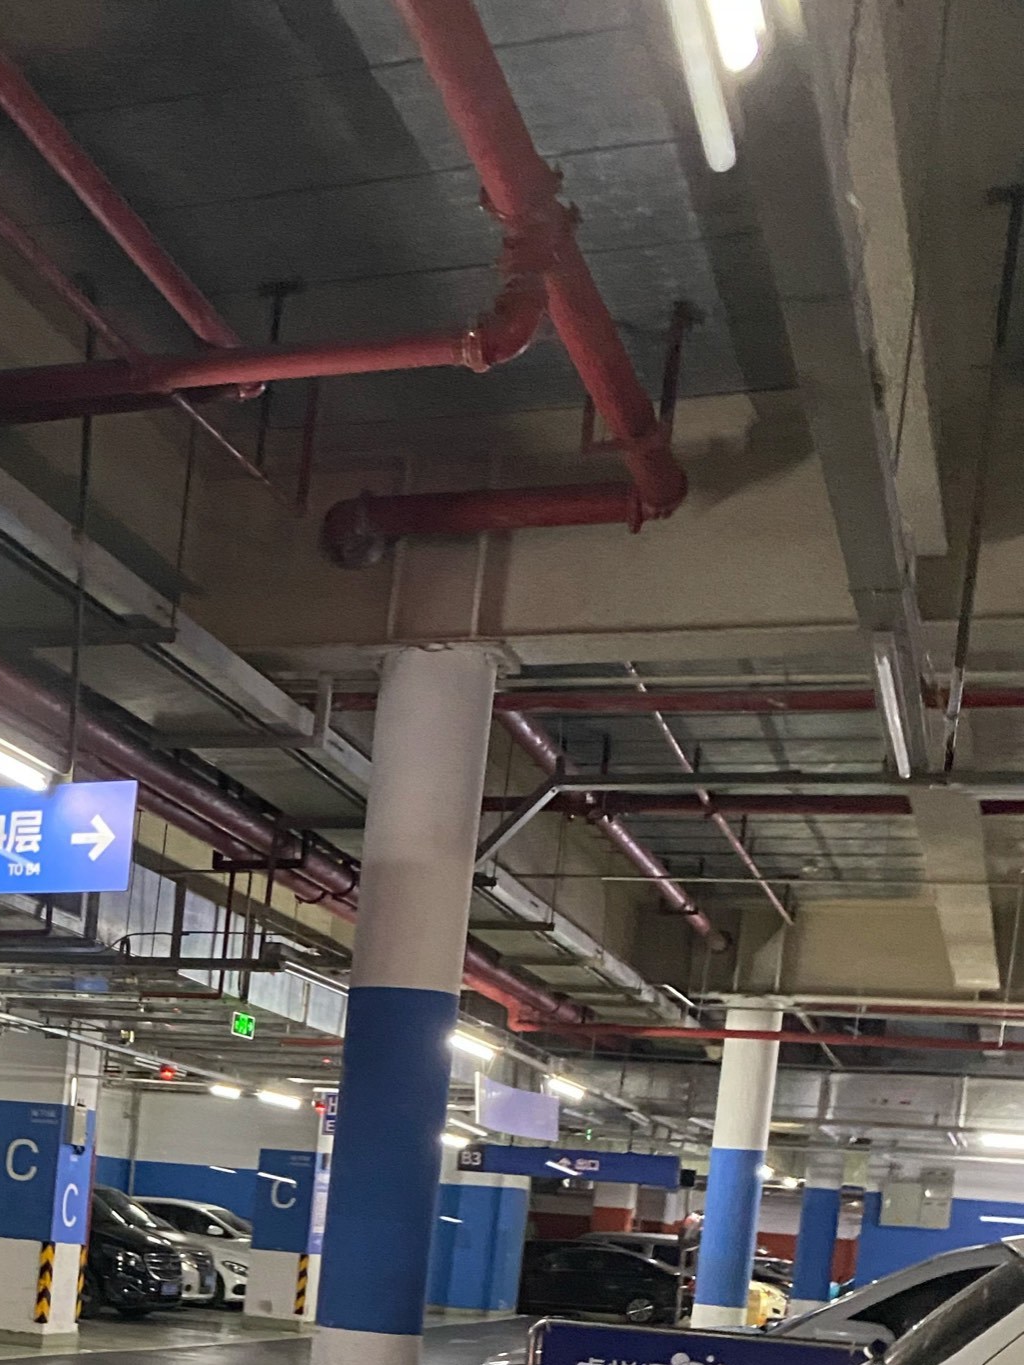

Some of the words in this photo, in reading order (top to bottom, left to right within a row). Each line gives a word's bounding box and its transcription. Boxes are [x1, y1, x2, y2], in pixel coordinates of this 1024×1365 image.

[8, 862, 23, 877] TO
[25, 862, 41, 877] B4
[6, 1138, 39, 1181] C
[460, 1150, 483, 1166] B3
[62, 1183, 79, 1228] C
[271, 1176, 297, 1209] C
